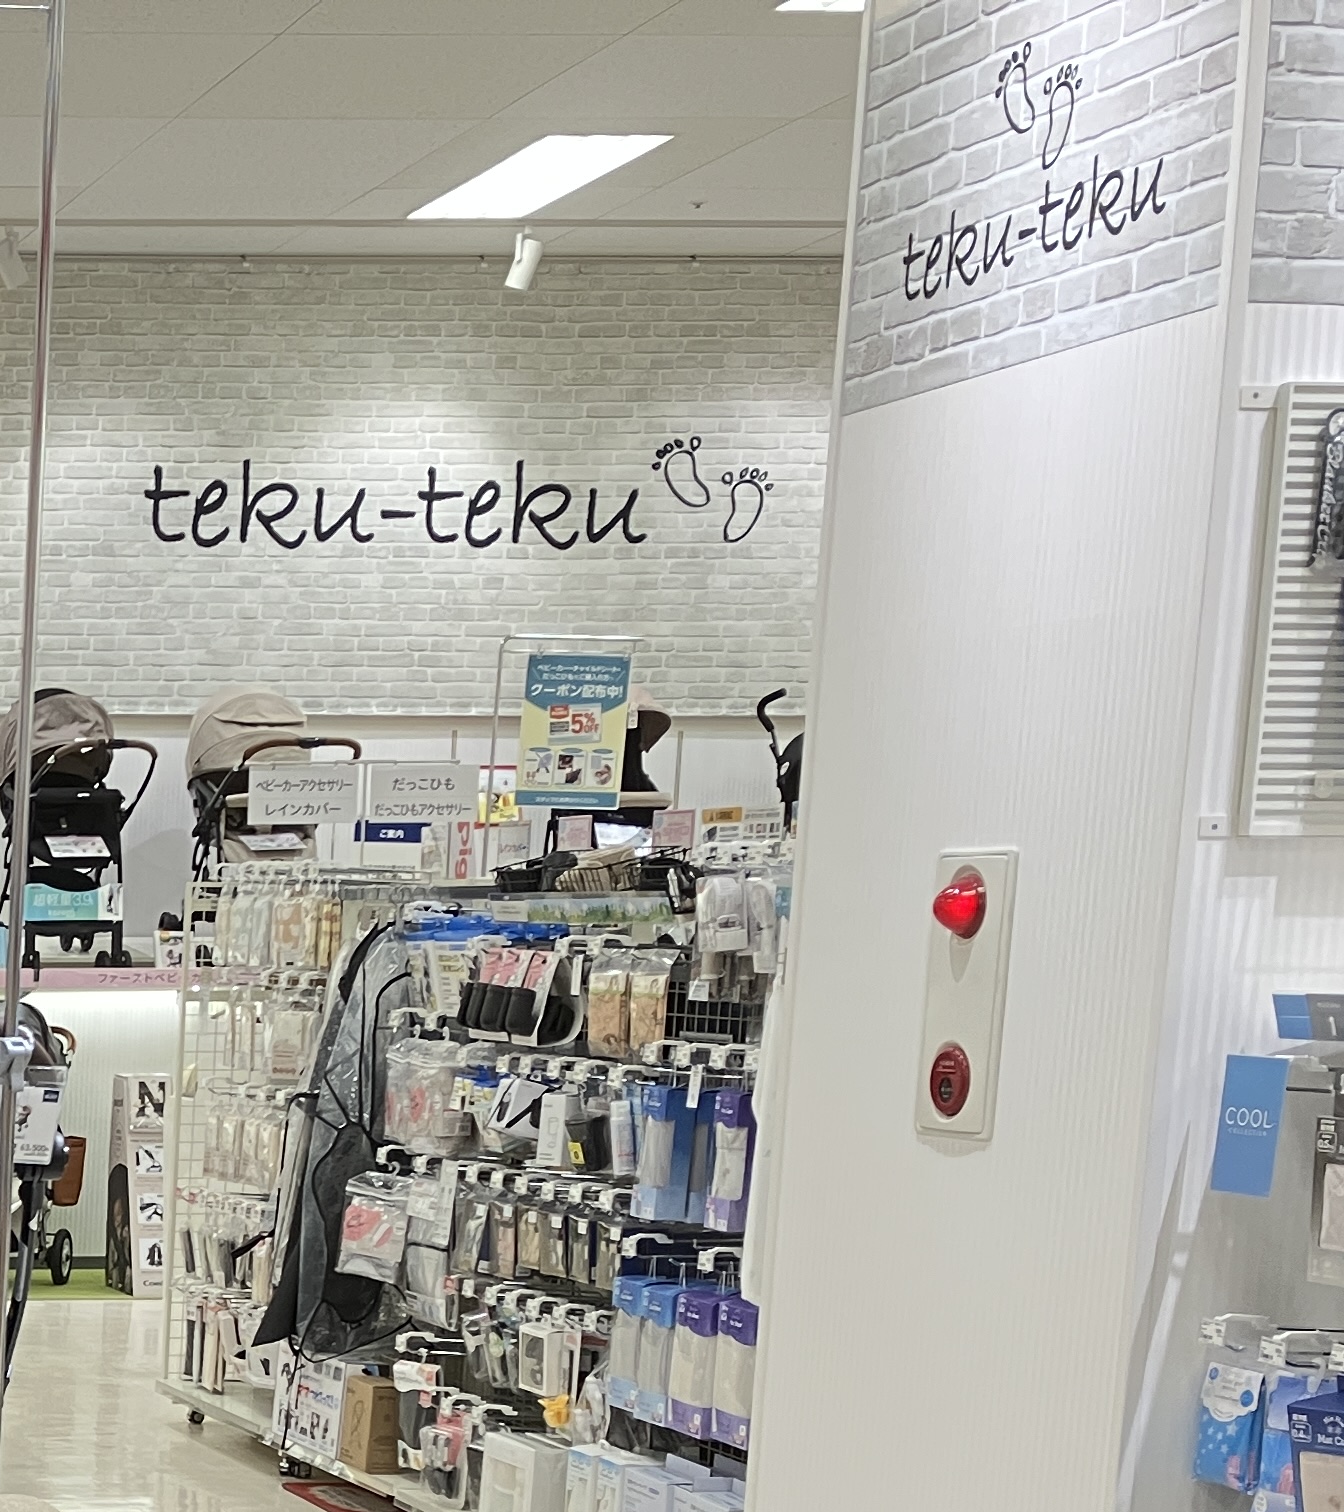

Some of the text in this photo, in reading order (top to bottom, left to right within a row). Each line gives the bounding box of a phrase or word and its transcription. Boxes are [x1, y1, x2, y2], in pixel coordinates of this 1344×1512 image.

[903, 154, 1166, 301] teku-teku
[144, 459, 648, 550] teku-teku
[531, 684, 623, 697] クーポン配布中!
[256, 778, 354, 793] ベビーカーアクセサリー
[392, 777, 455, 791] だっこひも
[265, 802, 341, 816] レインカバー
[374, 803, 472, 816] だっこひもアクセサリー
[379, 828, 404, 840] ご案内
[1226, 1107, 1277, 1128] COOL
